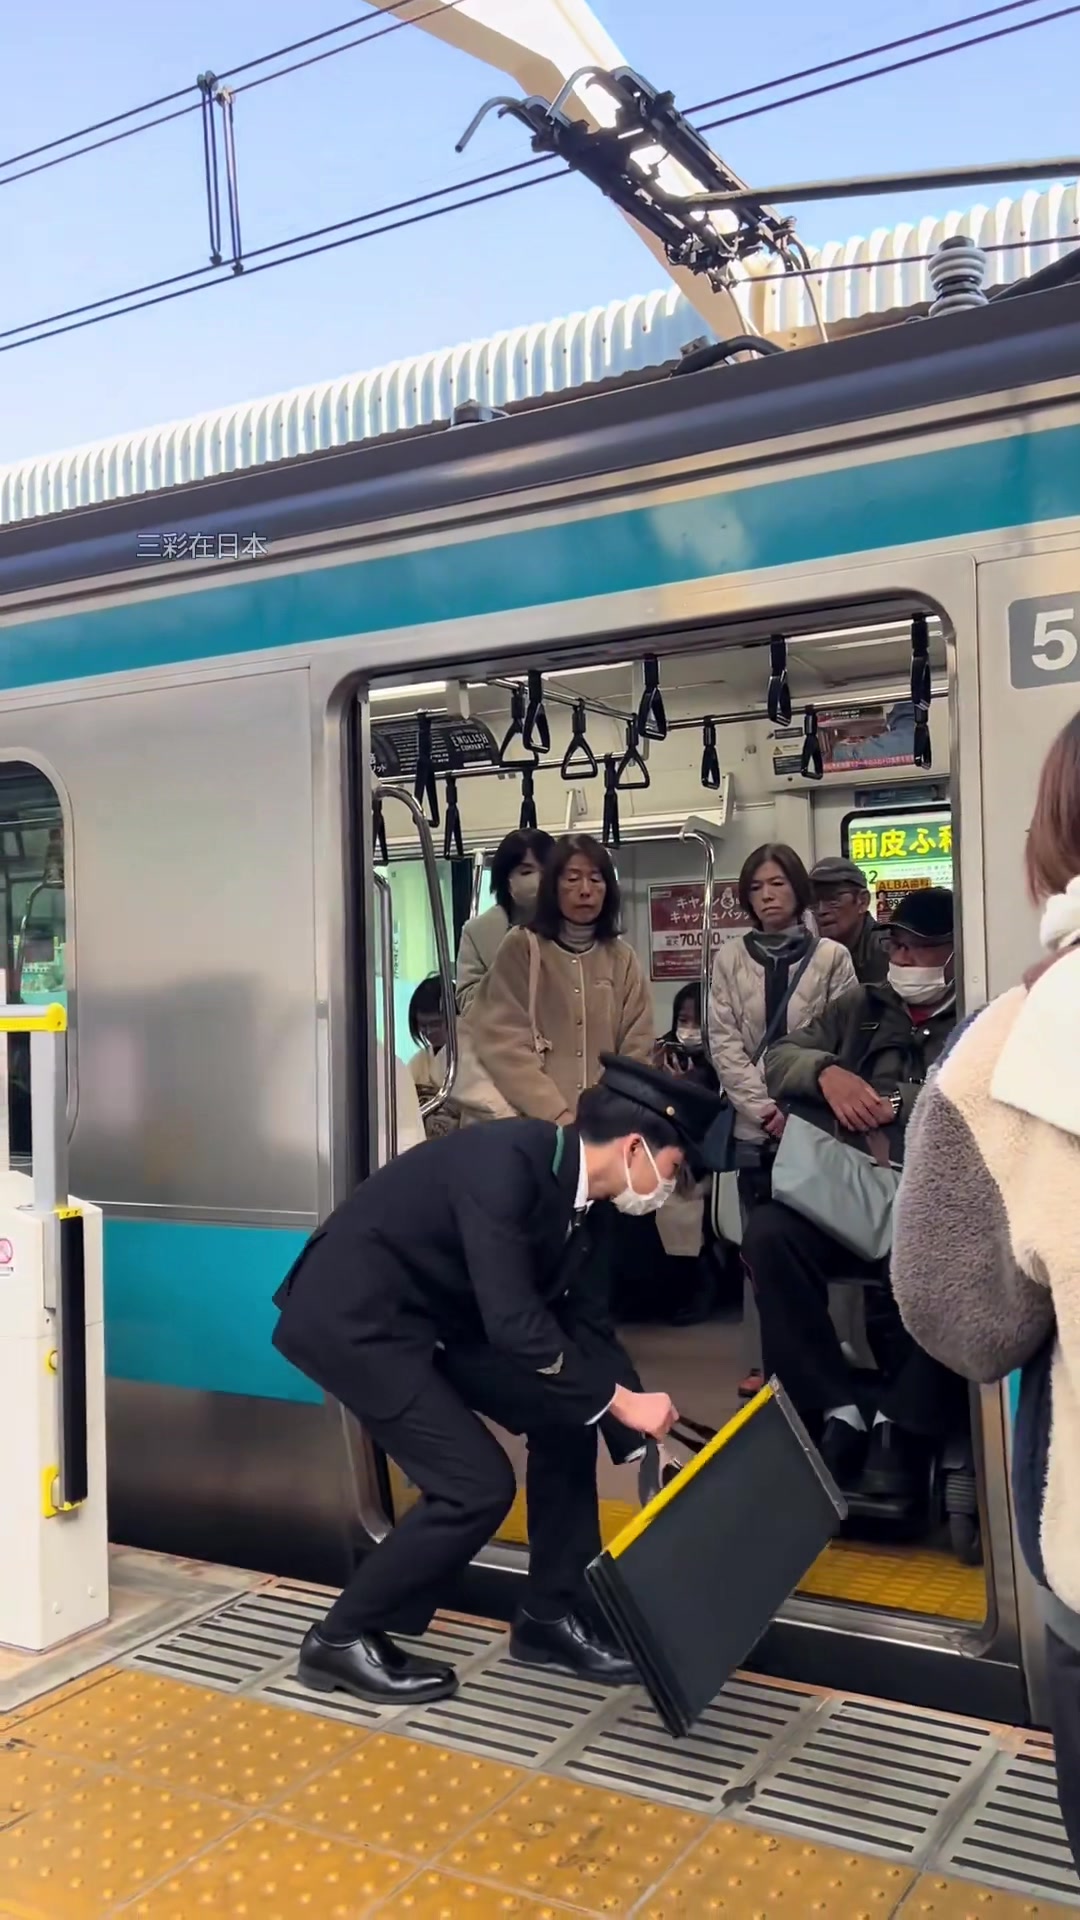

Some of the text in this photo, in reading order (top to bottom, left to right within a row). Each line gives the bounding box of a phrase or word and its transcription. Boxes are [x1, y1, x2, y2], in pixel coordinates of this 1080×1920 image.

[1031, 608, 1078, 671] 5
[451, 733, 489, 747] ENGLISH
[670, 909, 750, 924] キャッュバッ
[680, 932, 721, 946] 70,00
